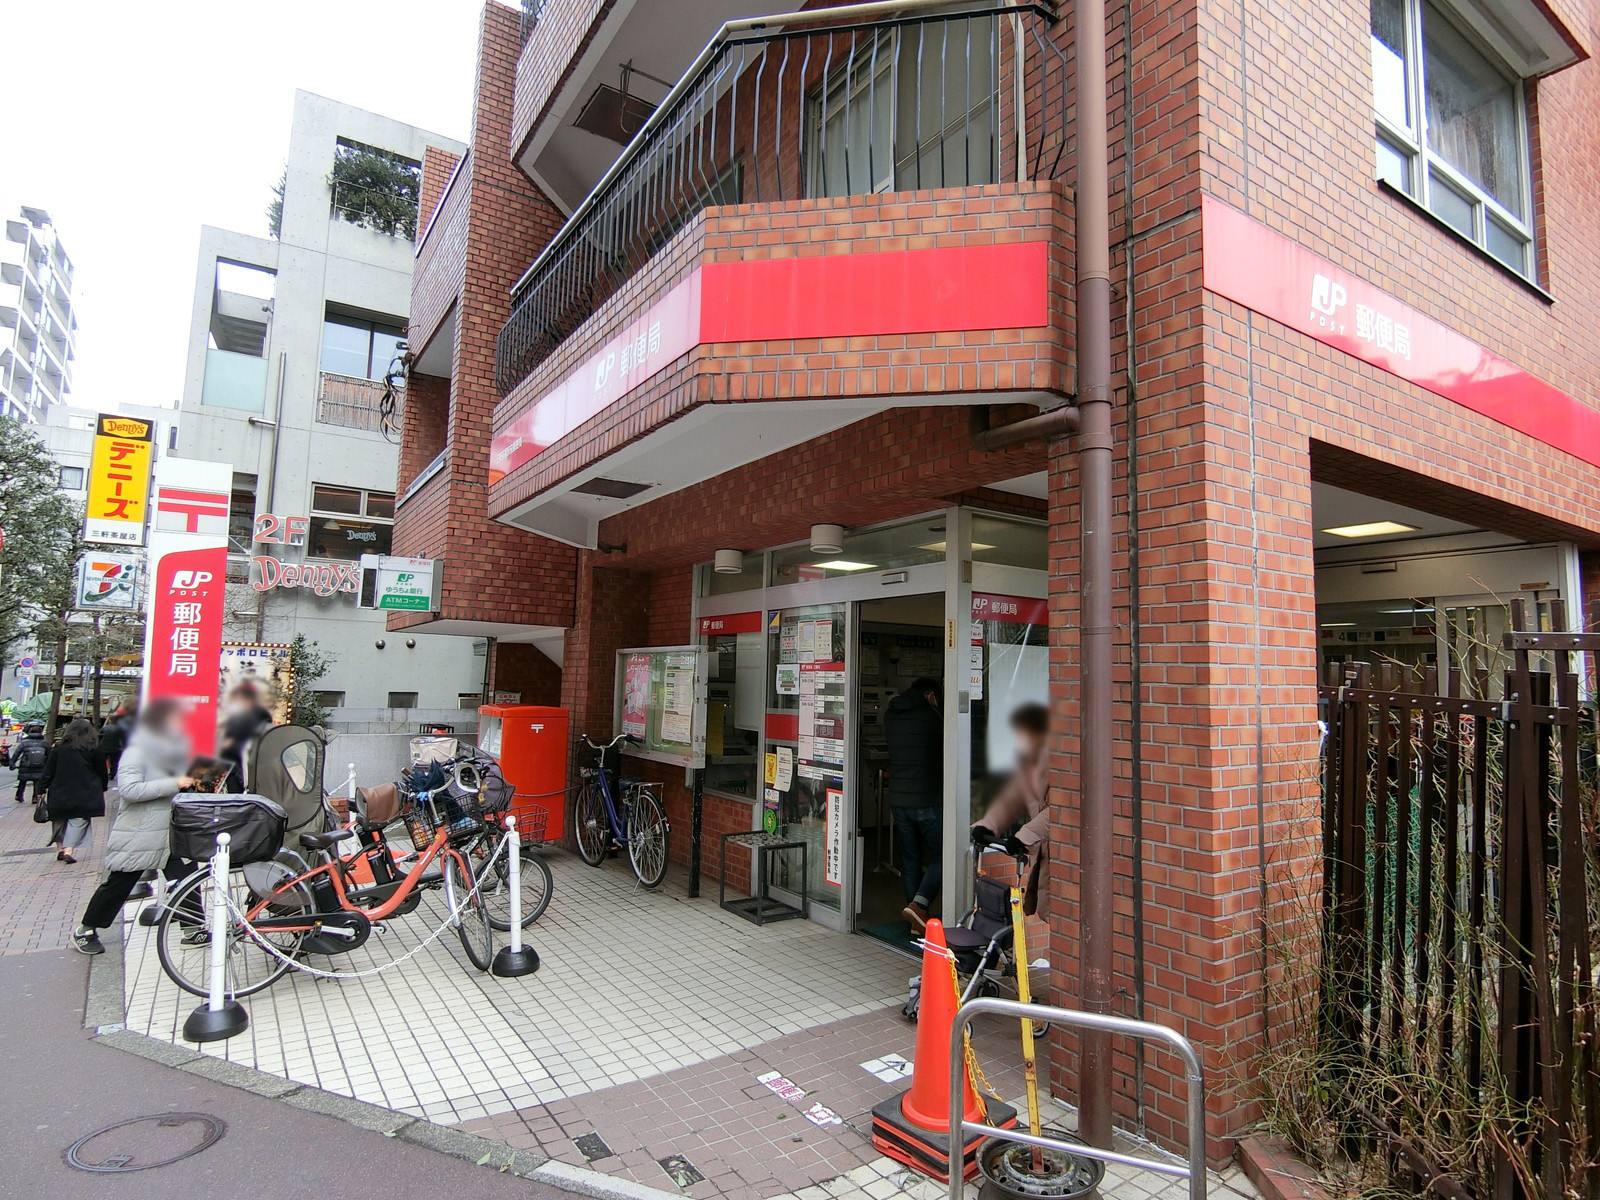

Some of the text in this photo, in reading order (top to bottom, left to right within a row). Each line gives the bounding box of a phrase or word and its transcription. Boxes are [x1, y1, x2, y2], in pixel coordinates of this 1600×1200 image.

[1309, 311, 1344, 335] POST
[1355, 303, 1410, 360] 郵便局
[620, 320, 661, 378] 郵便局
[107, 420, 144, 434] Denny's
[103, 441, 145, 519] デニーズ
[91, 529, 136, 540] 三軒茶屋店
[253, 513, 309, 544] 2F
[346, 530, 376, 542] Denny's
[252, 555, 360, 596] Denny's
[385, 586, 423, 594] ゆうちょ銀行
[991, 601, 1017, 615] 郵便局
[168, 602, 201, 676] 郵便局
[1338, 631, 1345, 641] 4
